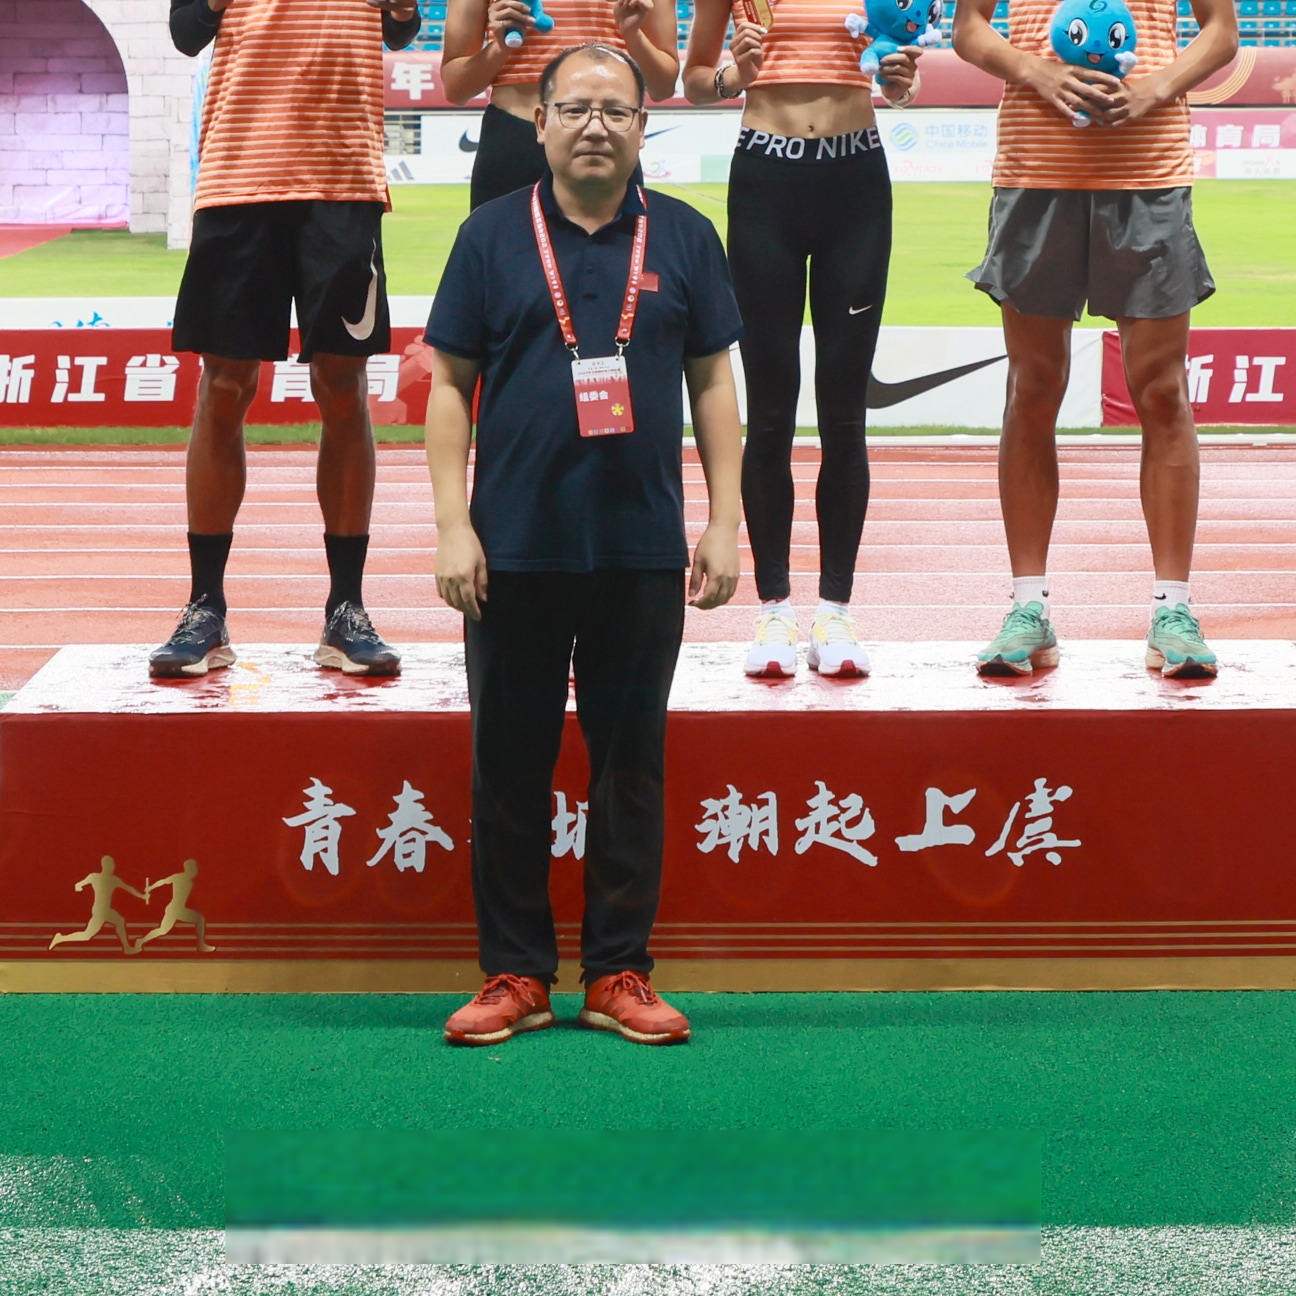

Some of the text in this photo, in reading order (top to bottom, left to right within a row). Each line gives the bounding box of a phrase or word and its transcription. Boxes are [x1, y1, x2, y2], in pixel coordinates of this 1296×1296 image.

[746, 131, 805, 160] PRO
[816, 127, 881, 160] NIKE
[694, 777, 1082, 868] 潮起上虞
